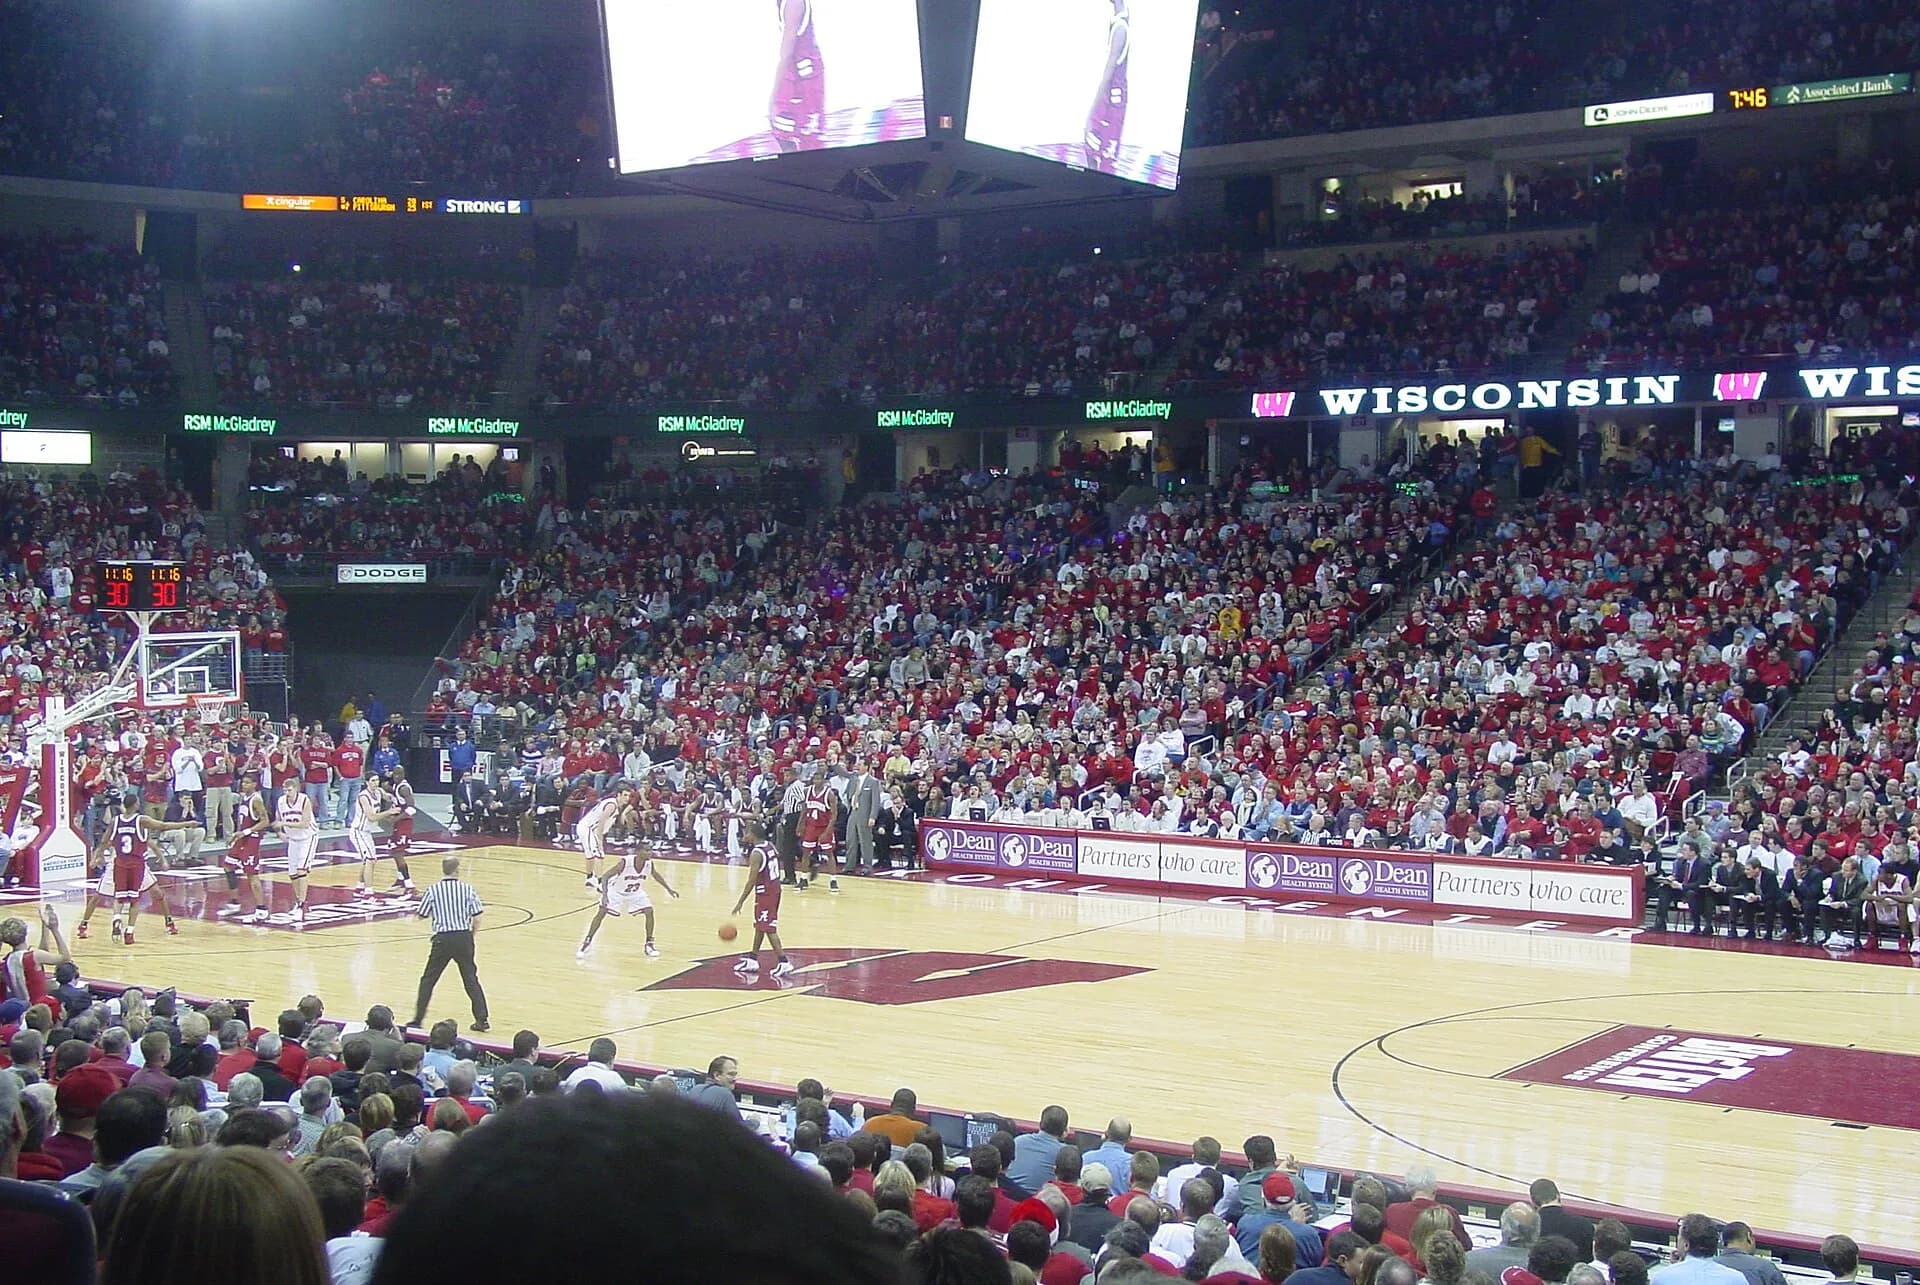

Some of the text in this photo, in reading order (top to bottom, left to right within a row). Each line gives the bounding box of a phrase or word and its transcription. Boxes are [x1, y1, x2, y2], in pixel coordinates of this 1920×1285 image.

[1729, 88, 1767, 109] 7:46
[1803, 79, 1893, 98] Associated Bank
[275, 195, 313, 208] cingular
[446, 199, 506, 214] STRONG
[1319, 375, 1680, 416] WISCONSIN
[901, 409, 955, 428] McGladrey
[1113, 399, 1172, 420] McGladrey
[213, 415, 276, 435] McGladrey
[457, 417, 519, 437] McGladrey
[686, 415, 745, 434] McGladrey
[354, 568, 425, 578] DODGE
[106, 582, 129, 606] 30
[152, 582, 176, 607] 30
[121, 835, 133, 854] 3
[952, 829, 996, 851] Dean
[1028, 835, 1074, 858] Dean
[1081, 845, 1152, 869] Partners
[1158, 853, 1195, 872] who
[1281, 854, 1334, 878] Dean
[1374, 860, 1429, 885] Dean
[624, 882, 641, 892] 23
[1281, 879, 1334, 890] HEALTH SYSTEM
[1374, 886, 1429, 897] HEALTH SYSTEM
[1437, 871, 1521, 897] Partners
[1529, 880, 1573, 901] who
[1208, 896, 1646, 940] CENTER
